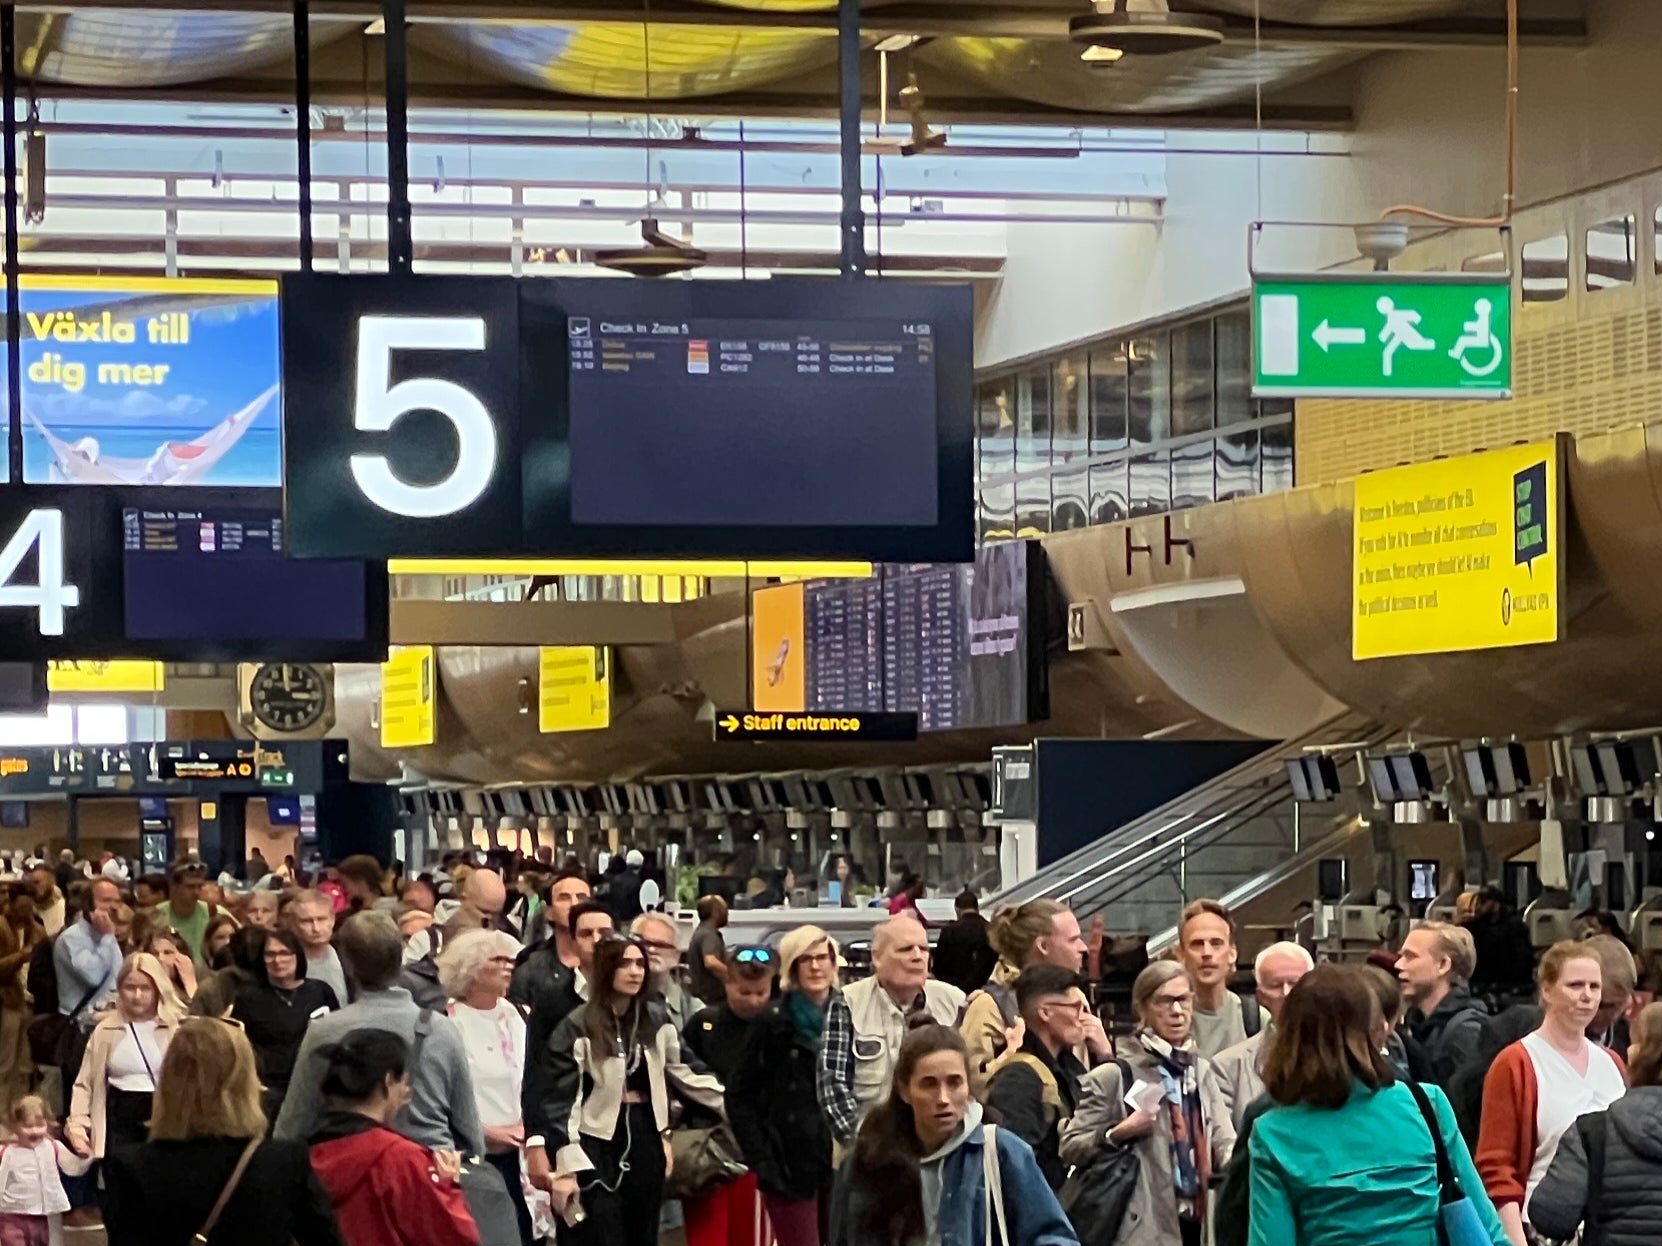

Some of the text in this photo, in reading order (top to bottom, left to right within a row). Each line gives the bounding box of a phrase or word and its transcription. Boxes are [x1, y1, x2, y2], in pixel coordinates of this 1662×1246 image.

[26, 311, 190, 345] Växla till
[28, 351, 170, 393] dig mer
[349, 315, 498, 519] 5
[0, 508, 80, 636] 4
[743, 714, 861, 731] Staff entrance
